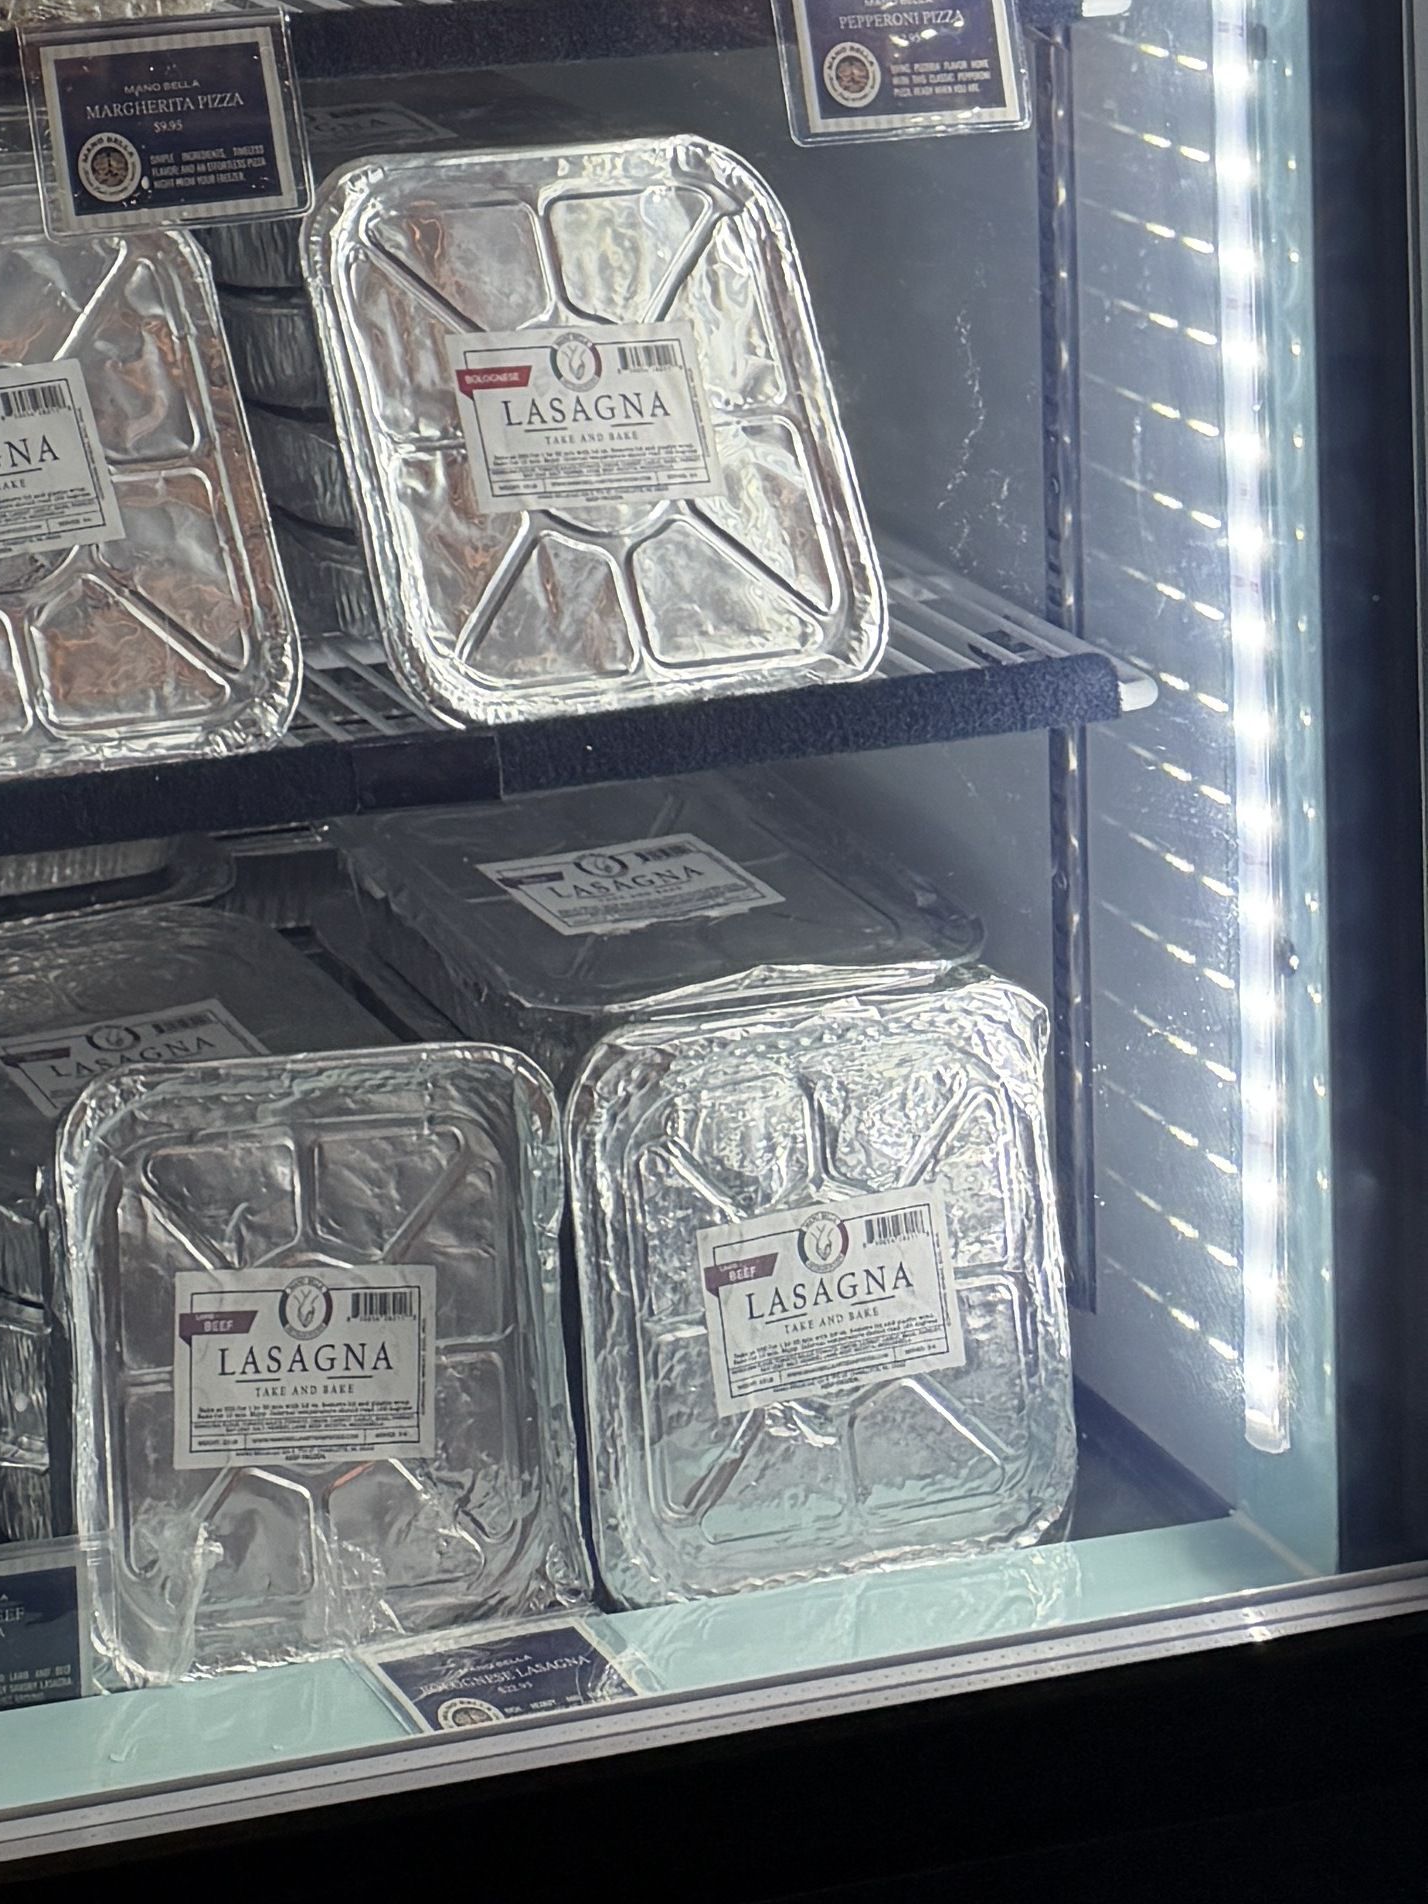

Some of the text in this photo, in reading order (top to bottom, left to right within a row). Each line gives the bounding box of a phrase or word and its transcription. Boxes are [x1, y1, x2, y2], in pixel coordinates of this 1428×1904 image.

[839, 10, 964, 30] PEPPERONI PIZZA
[124, 80, 201, 95] MANO BELLA
[86, 93, 244, 120] MARGHERITA PIZZA
[464, 372, 520, 385] BOLOGNESE
[502, 392, 671, 427] LASAGNA
[546, 860, 706, 900] LASAGNA
[729, 1267, 757, 1280] BEEF
[747, 1261, 914, 1320] LASAGNA
[203, 1320, 234, 1332] BEEF
[218, 1341, 394, 1376] LASAGNA
[518, 1655, 592, 1678] LASAGNA
